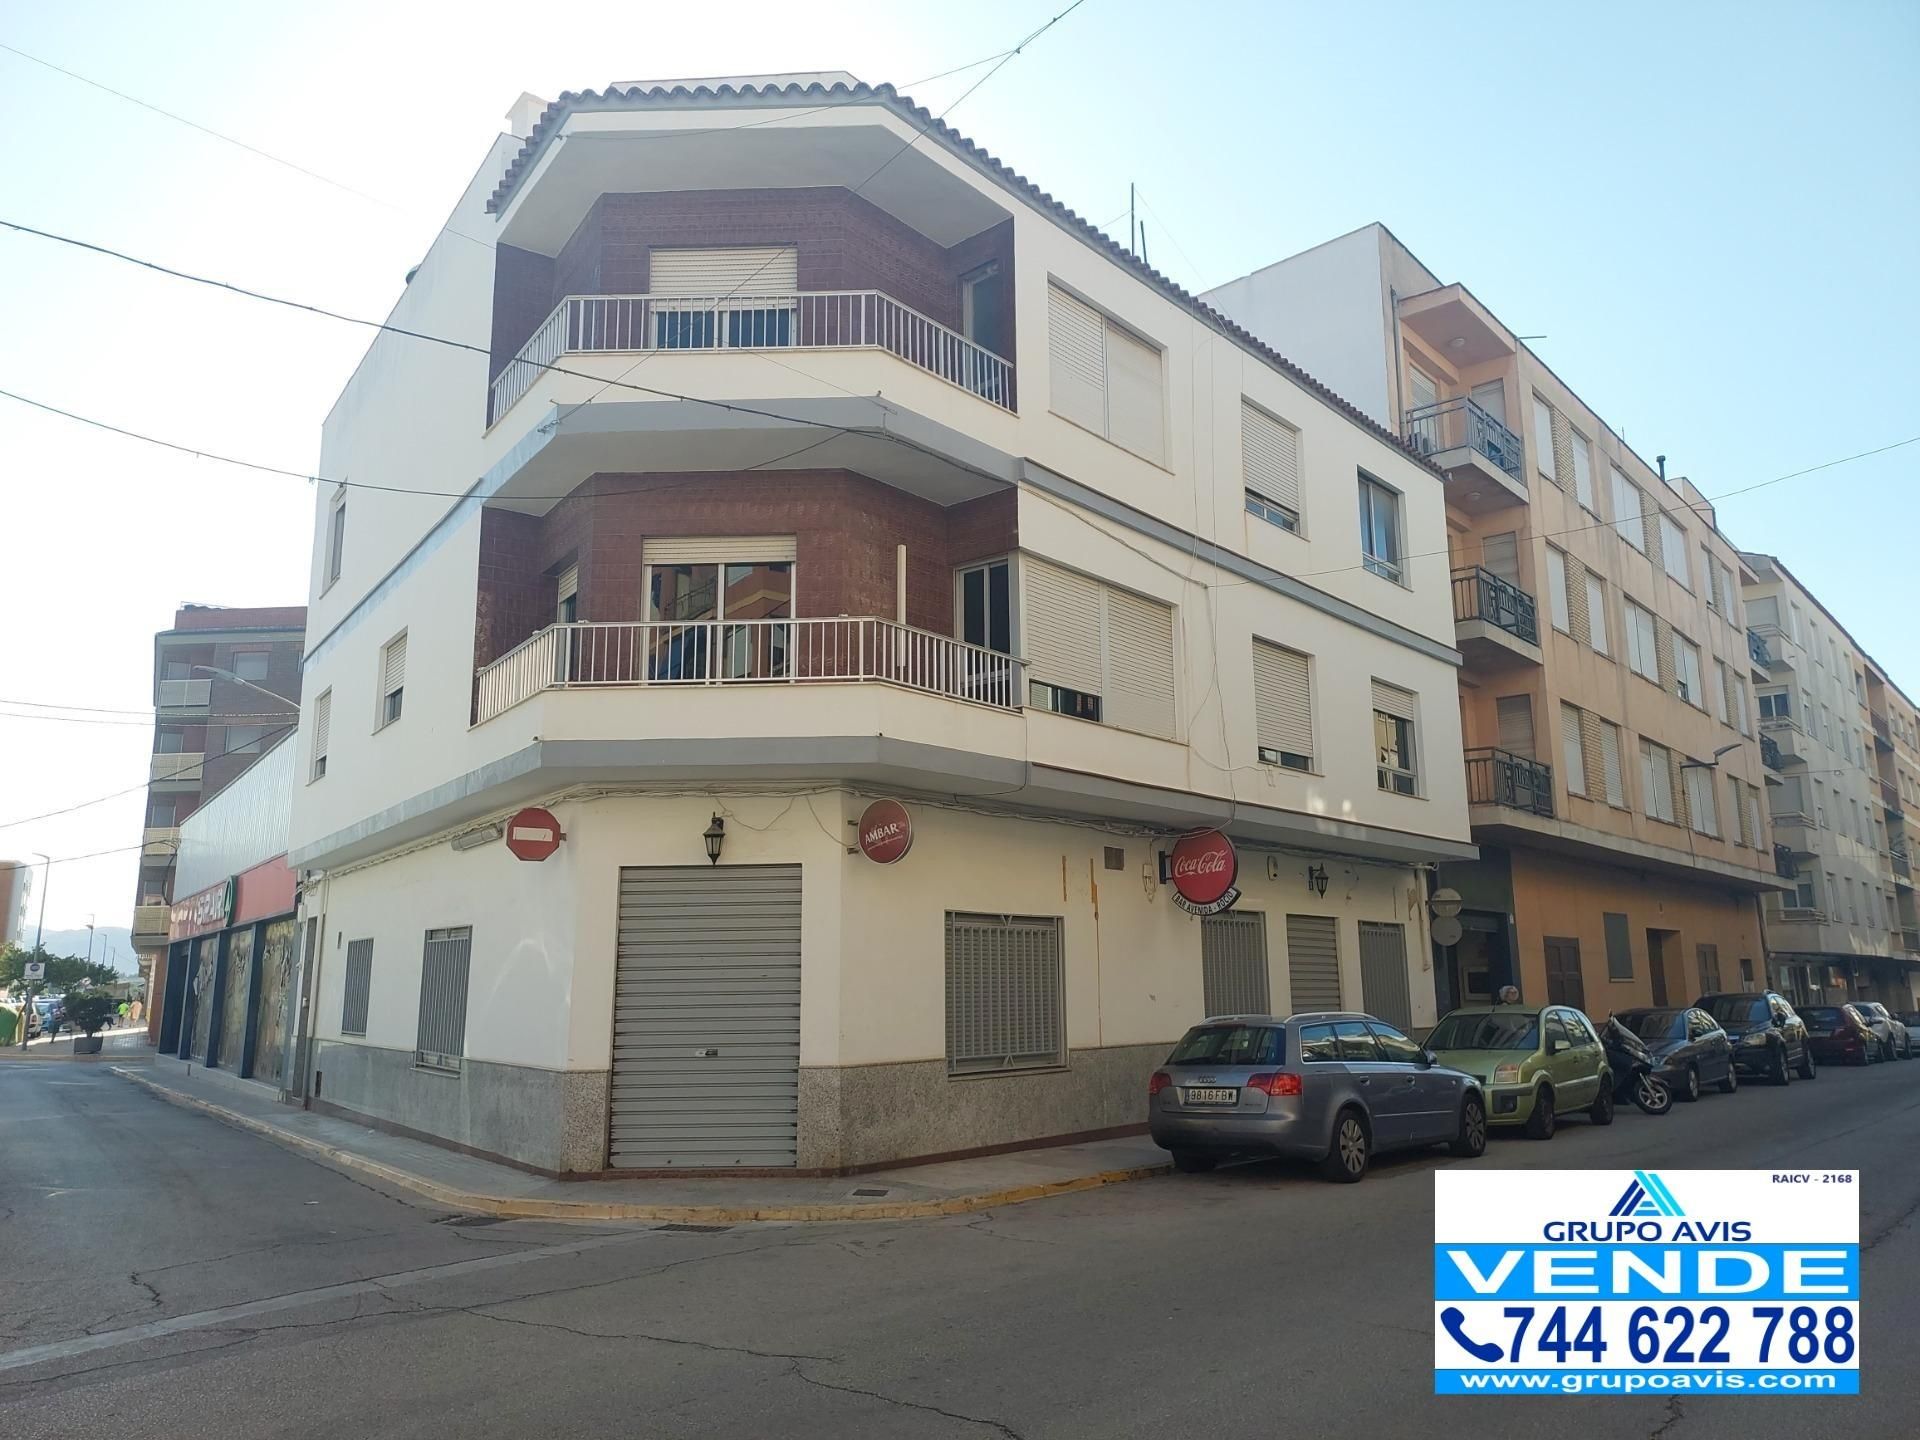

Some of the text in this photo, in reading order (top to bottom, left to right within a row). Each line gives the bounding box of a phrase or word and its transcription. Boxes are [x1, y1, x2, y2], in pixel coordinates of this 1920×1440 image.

[865, 823, 899, 844] AMBAR
[1175, 895, 1187, 907] BAR
[1187, 903, 1213, 915] AVENIDA
